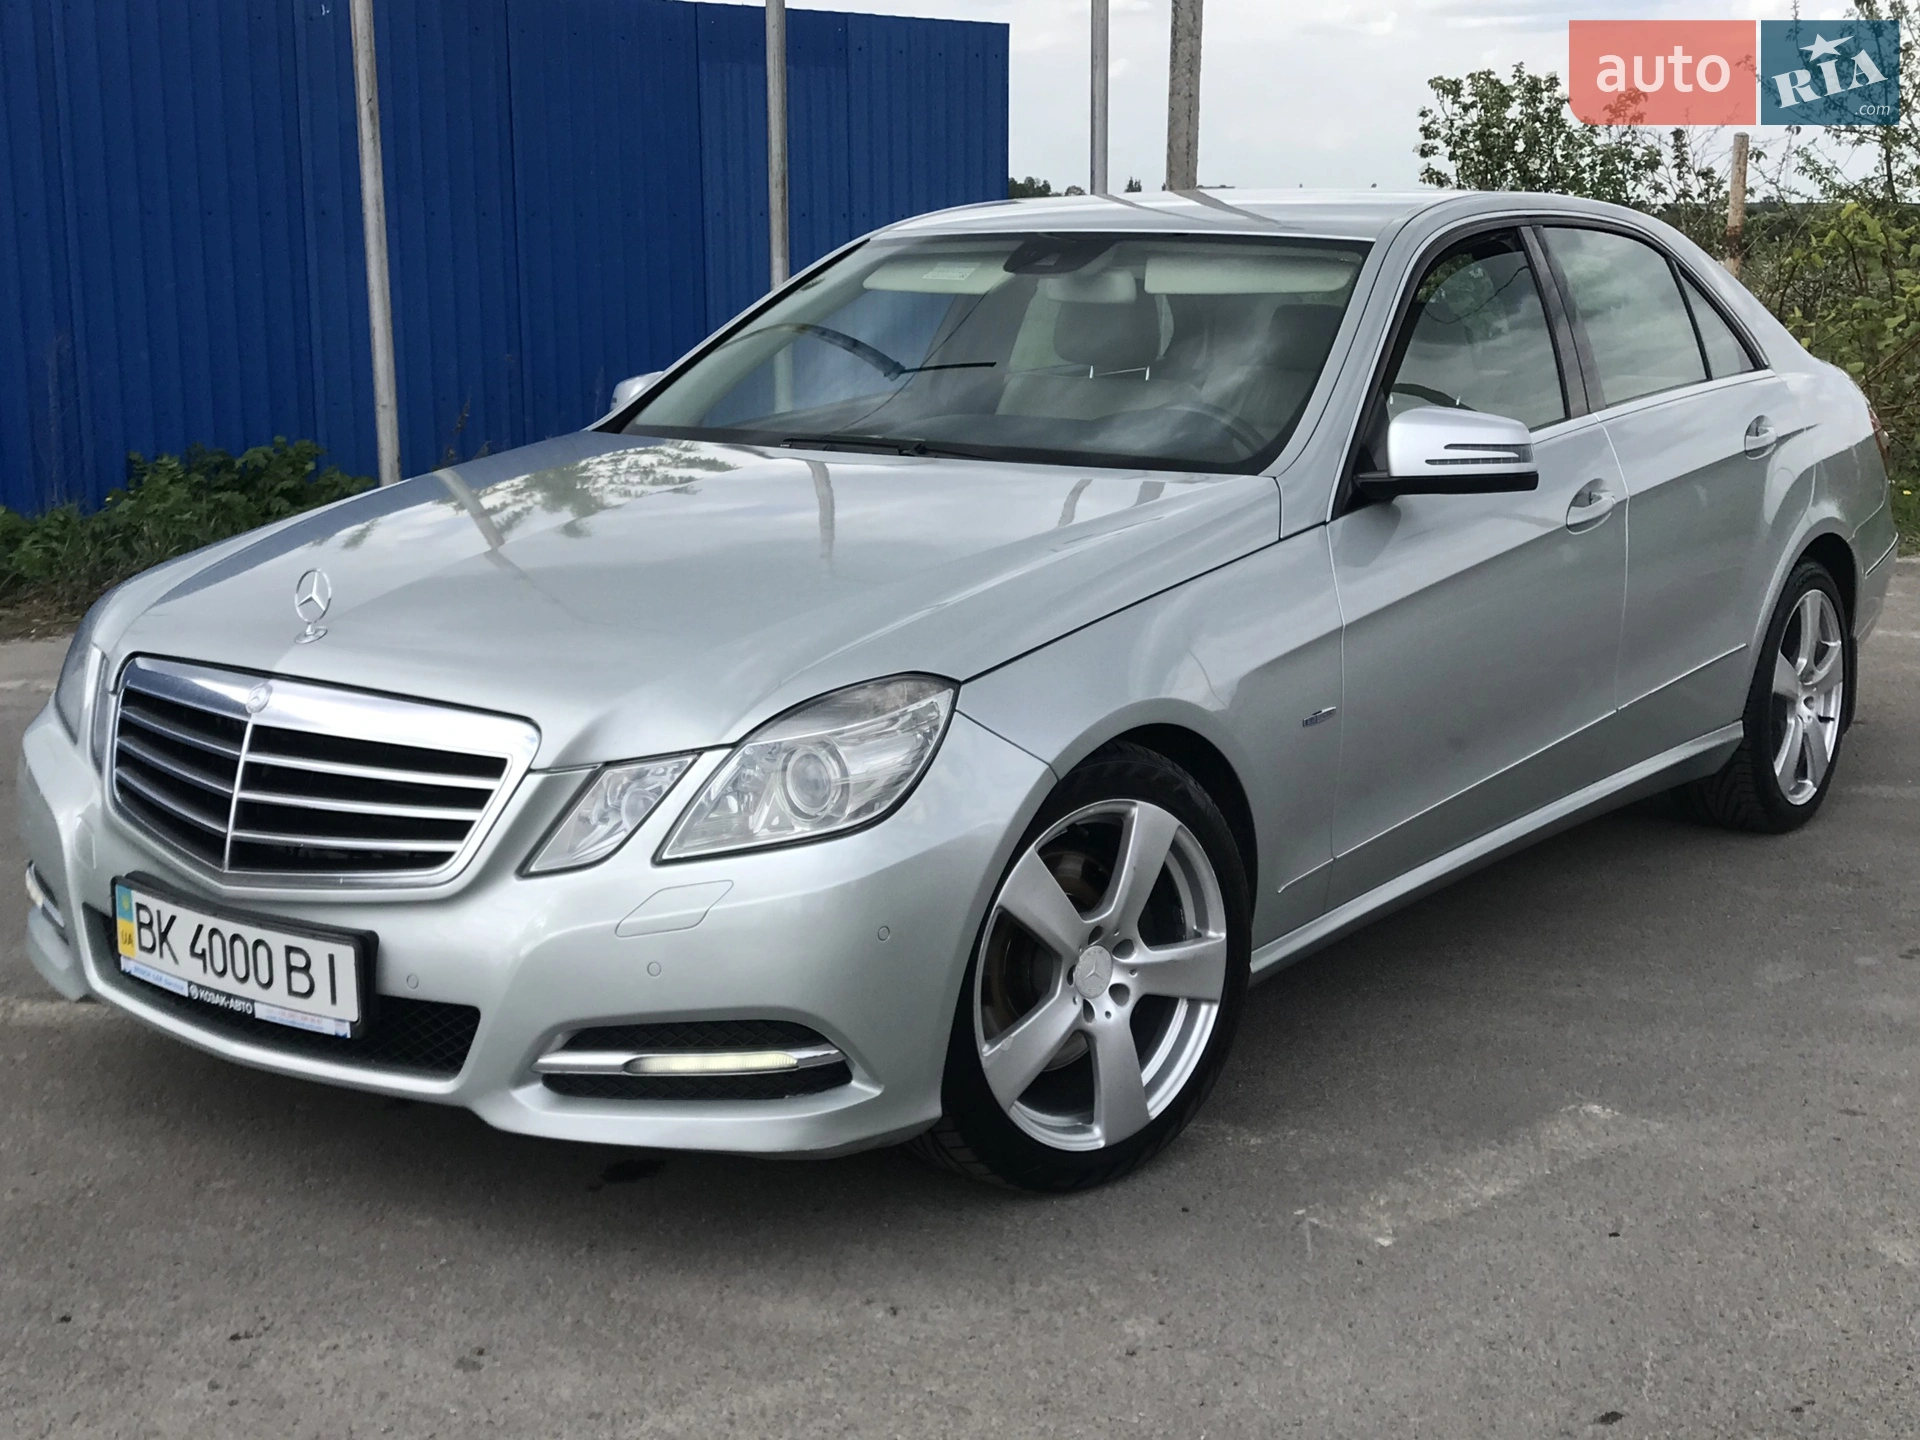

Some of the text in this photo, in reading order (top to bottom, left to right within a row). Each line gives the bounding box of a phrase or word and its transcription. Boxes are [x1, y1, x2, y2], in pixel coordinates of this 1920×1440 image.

[121, 931, 134, 948] UA
[136, 903, 178, 965] BK
[189, 924, 273, 989] 4000
